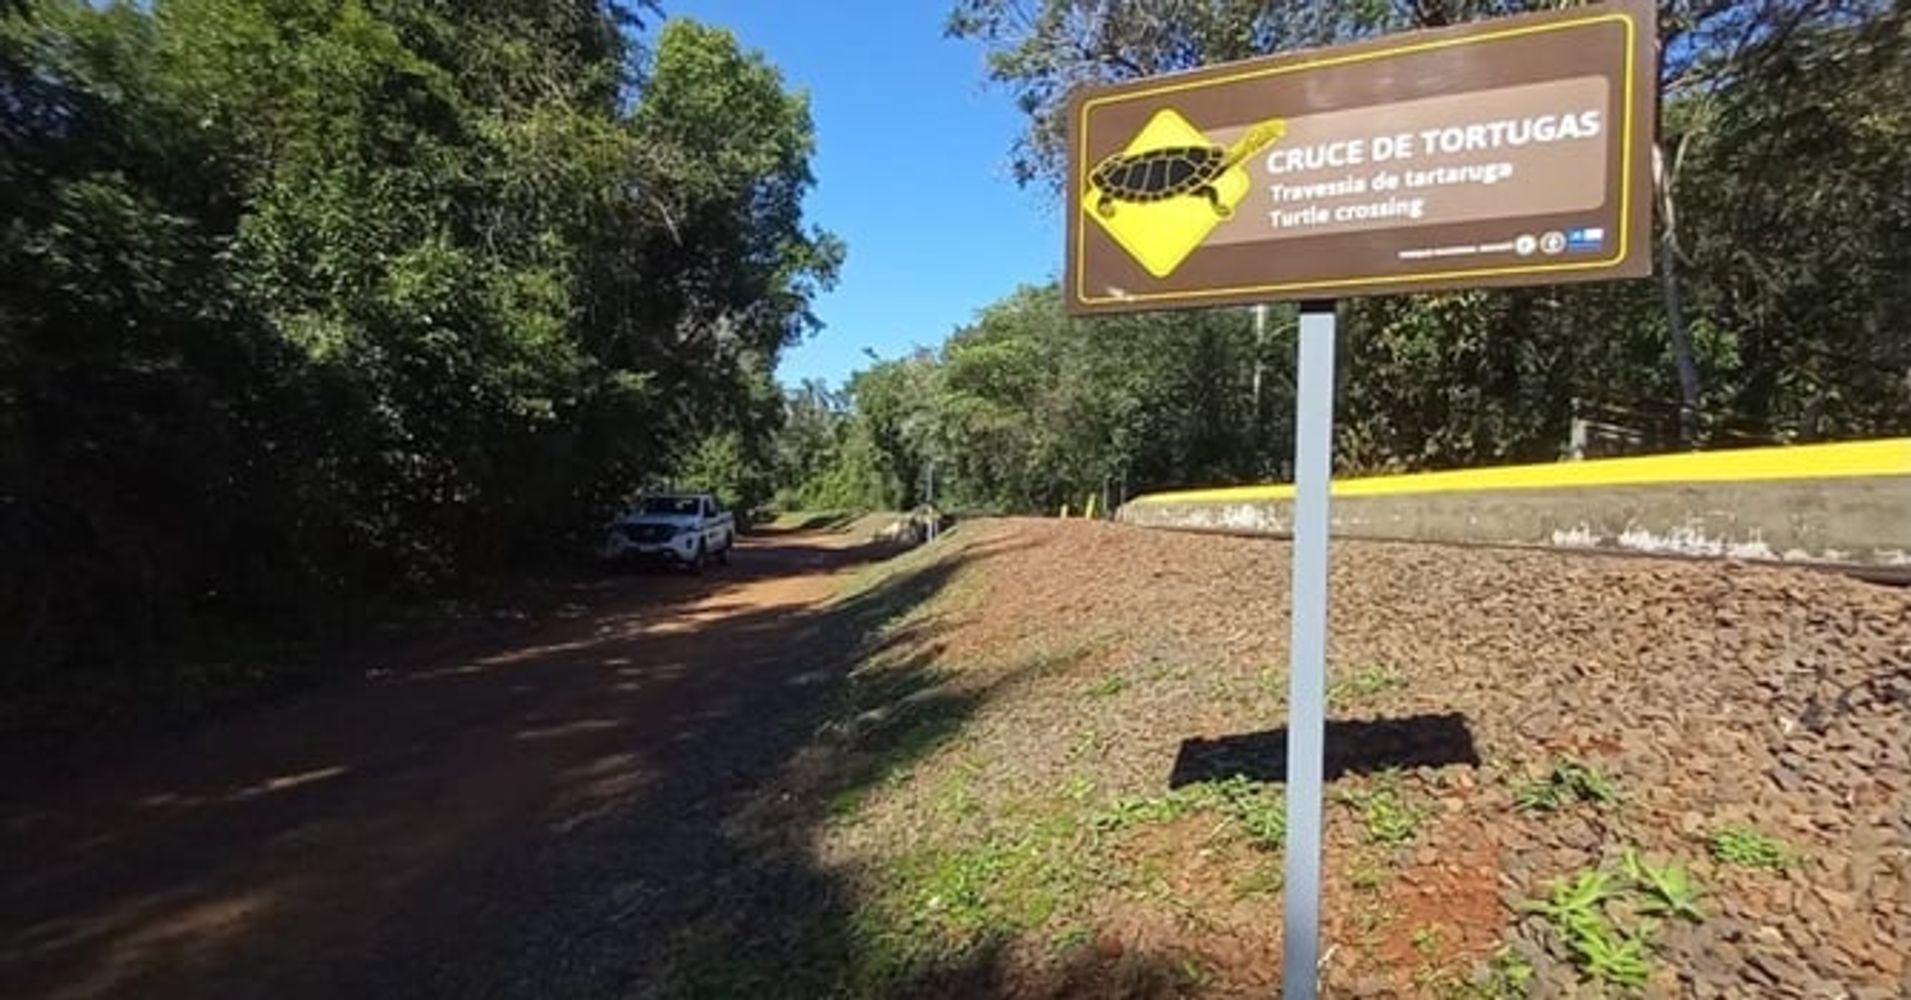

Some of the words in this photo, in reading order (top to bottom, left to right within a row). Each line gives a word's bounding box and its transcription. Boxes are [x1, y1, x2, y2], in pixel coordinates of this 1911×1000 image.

[1266, 140, 1365, 174] CRUCE
[1372, 134, 1414, 162] DE
[1420, 110, 1601, 155] TORTUGAS
[1269, 176, 1366, 202] Travessia
[1371, 170, 1399, 190] de
[1405, 162, 1514, 187] tartaruga
[1268, 204, 1330, 229] Turtle
[1334, 197, 1425, 221] crossing
